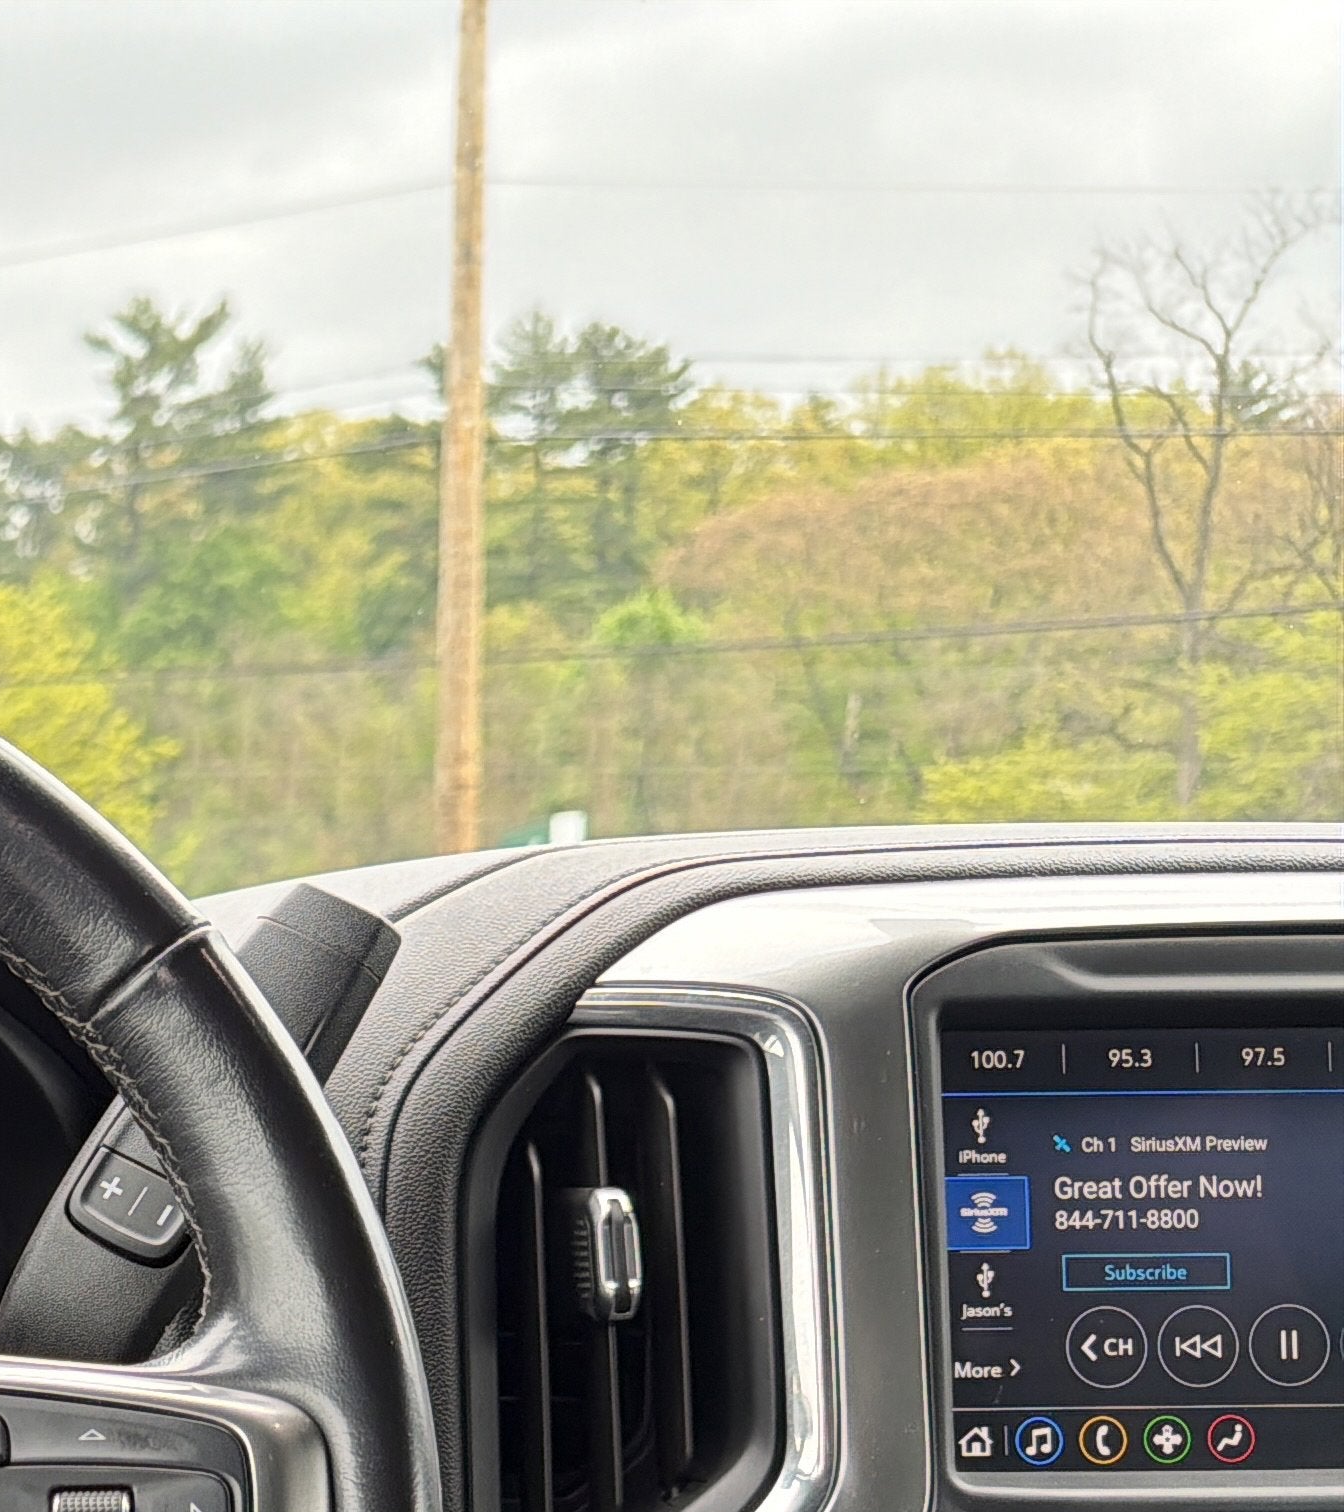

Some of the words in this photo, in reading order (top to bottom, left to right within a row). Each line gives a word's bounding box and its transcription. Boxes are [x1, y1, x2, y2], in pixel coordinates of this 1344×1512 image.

[970, 1049, 1025, 1070] 100.7
[1107, 1048, 1153, 1068] 95.3
[1240, 1047, 1286, 1067] 97.5
[1081, 1136, 1104, 1153] Ch
[1107, 1136, 1116, 1152] 1
[1130, 1136, 1202, 1153] SiriusXM
[1205, 1135, 1268, 1152] Preview
[1054, 1176, 1123, 1200] Great
[1130, 1175, 1193, 1199] Offer
[1198, 1174, 1263, 1198] Now!
[1054, 1208, 1200, 1230] 844-711-8800
[1104, 1263, 1188, 1282] Subscribe
[960, 1302, 1013, 1320] Jason's
[1102, 1337, 1134, 1356] CH
[954, 1361, 1003, 1379] More
